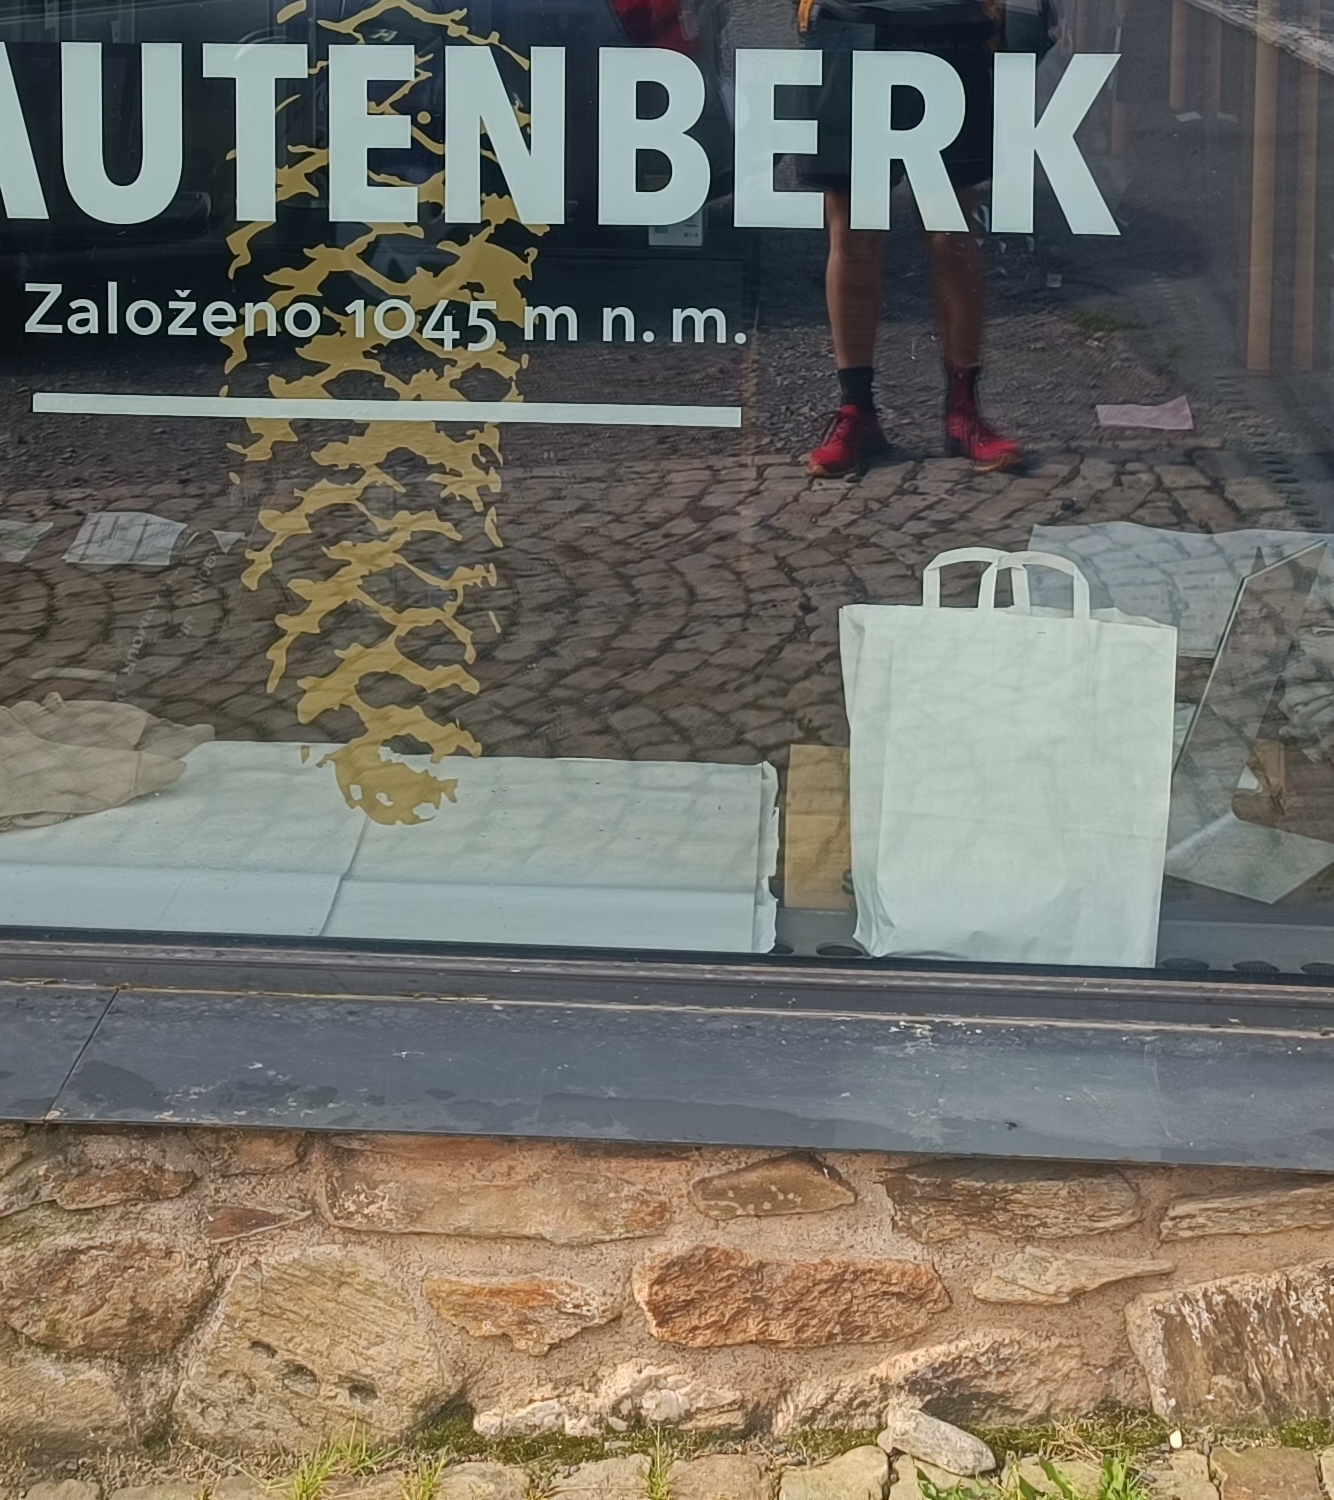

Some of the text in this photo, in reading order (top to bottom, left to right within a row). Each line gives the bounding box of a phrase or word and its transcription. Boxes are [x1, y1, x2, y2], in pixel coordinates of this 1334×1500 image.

[24, 281, 321, 338] Založeno
[344, 299, 497, 352] 1045
[524, 305, 578, 341] m
